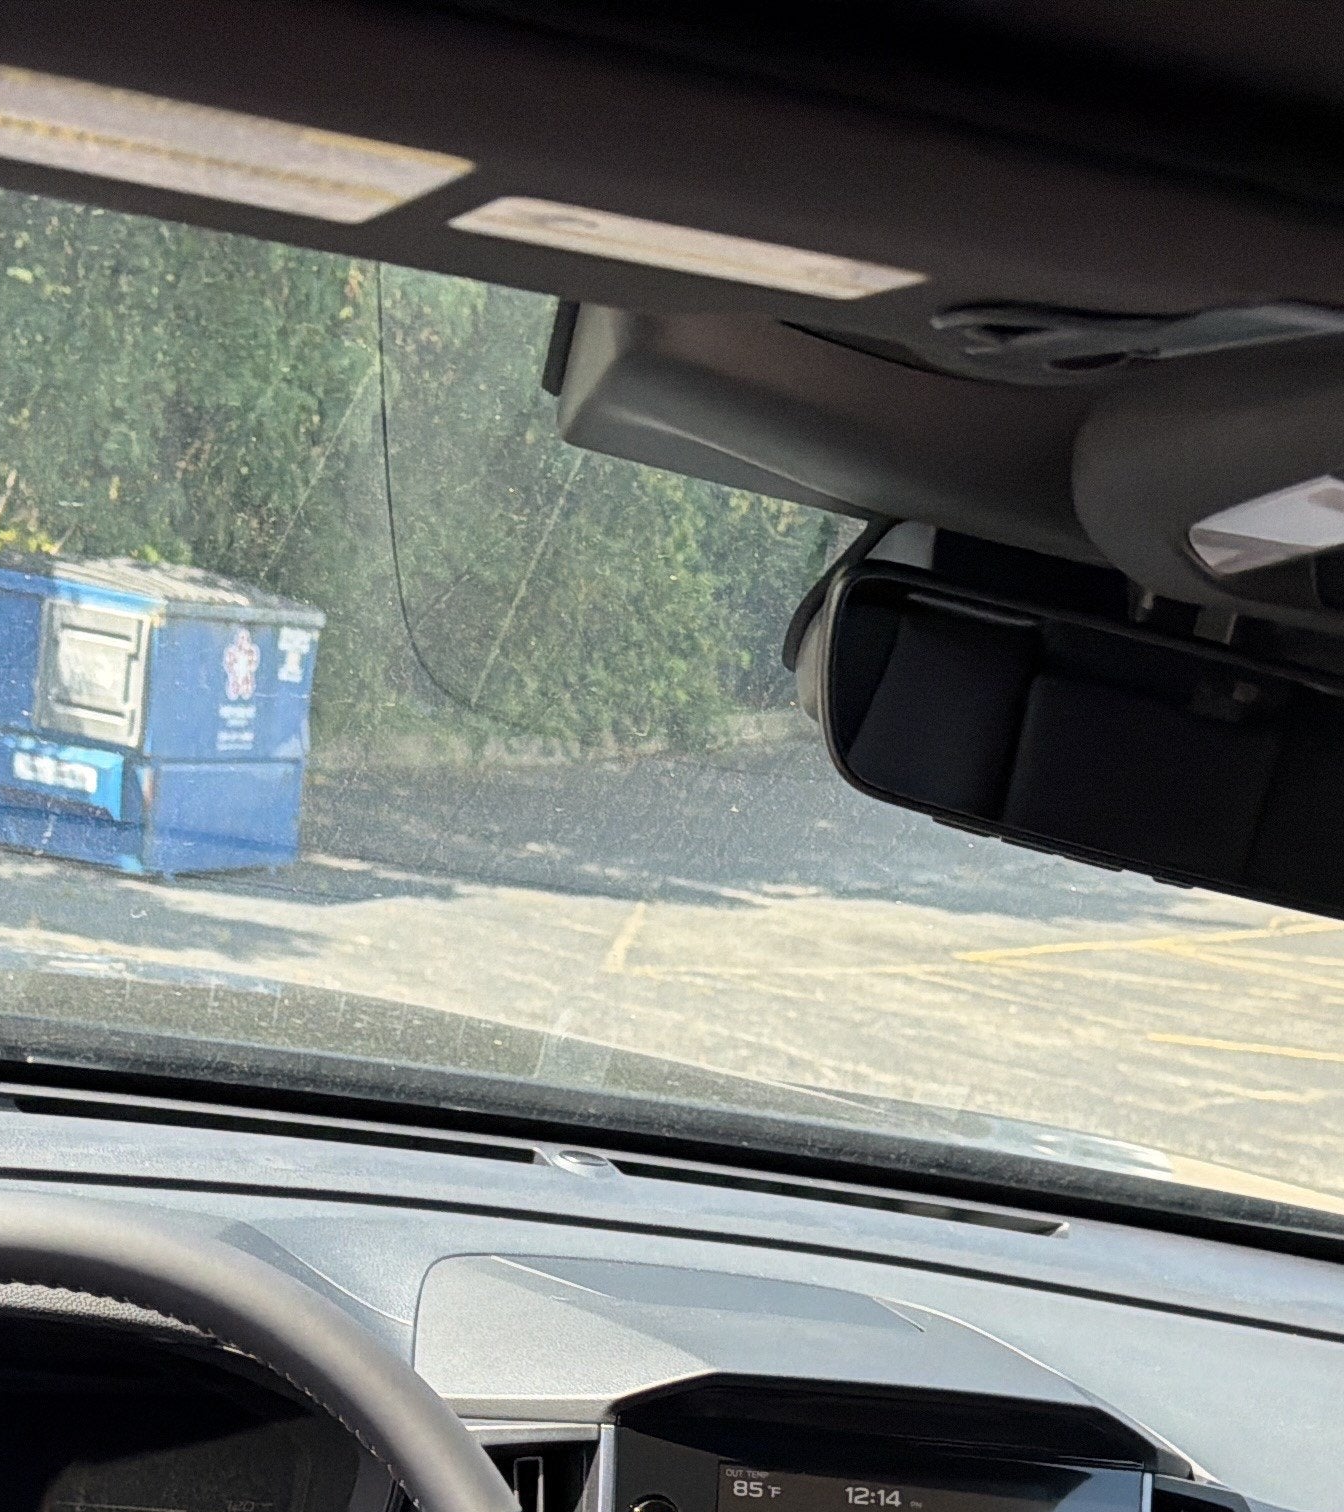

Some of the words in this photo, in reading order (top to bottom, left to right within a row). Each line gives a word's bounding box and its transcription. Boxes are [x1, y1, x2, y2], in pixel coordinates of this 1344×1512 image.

[725, 1468, 744, 1478] OUT
[746, 1470, 770, 1480] TEMP
[733, 1480, 763, 1497] 85
[845, 1487, 902, 1508] 12:14
